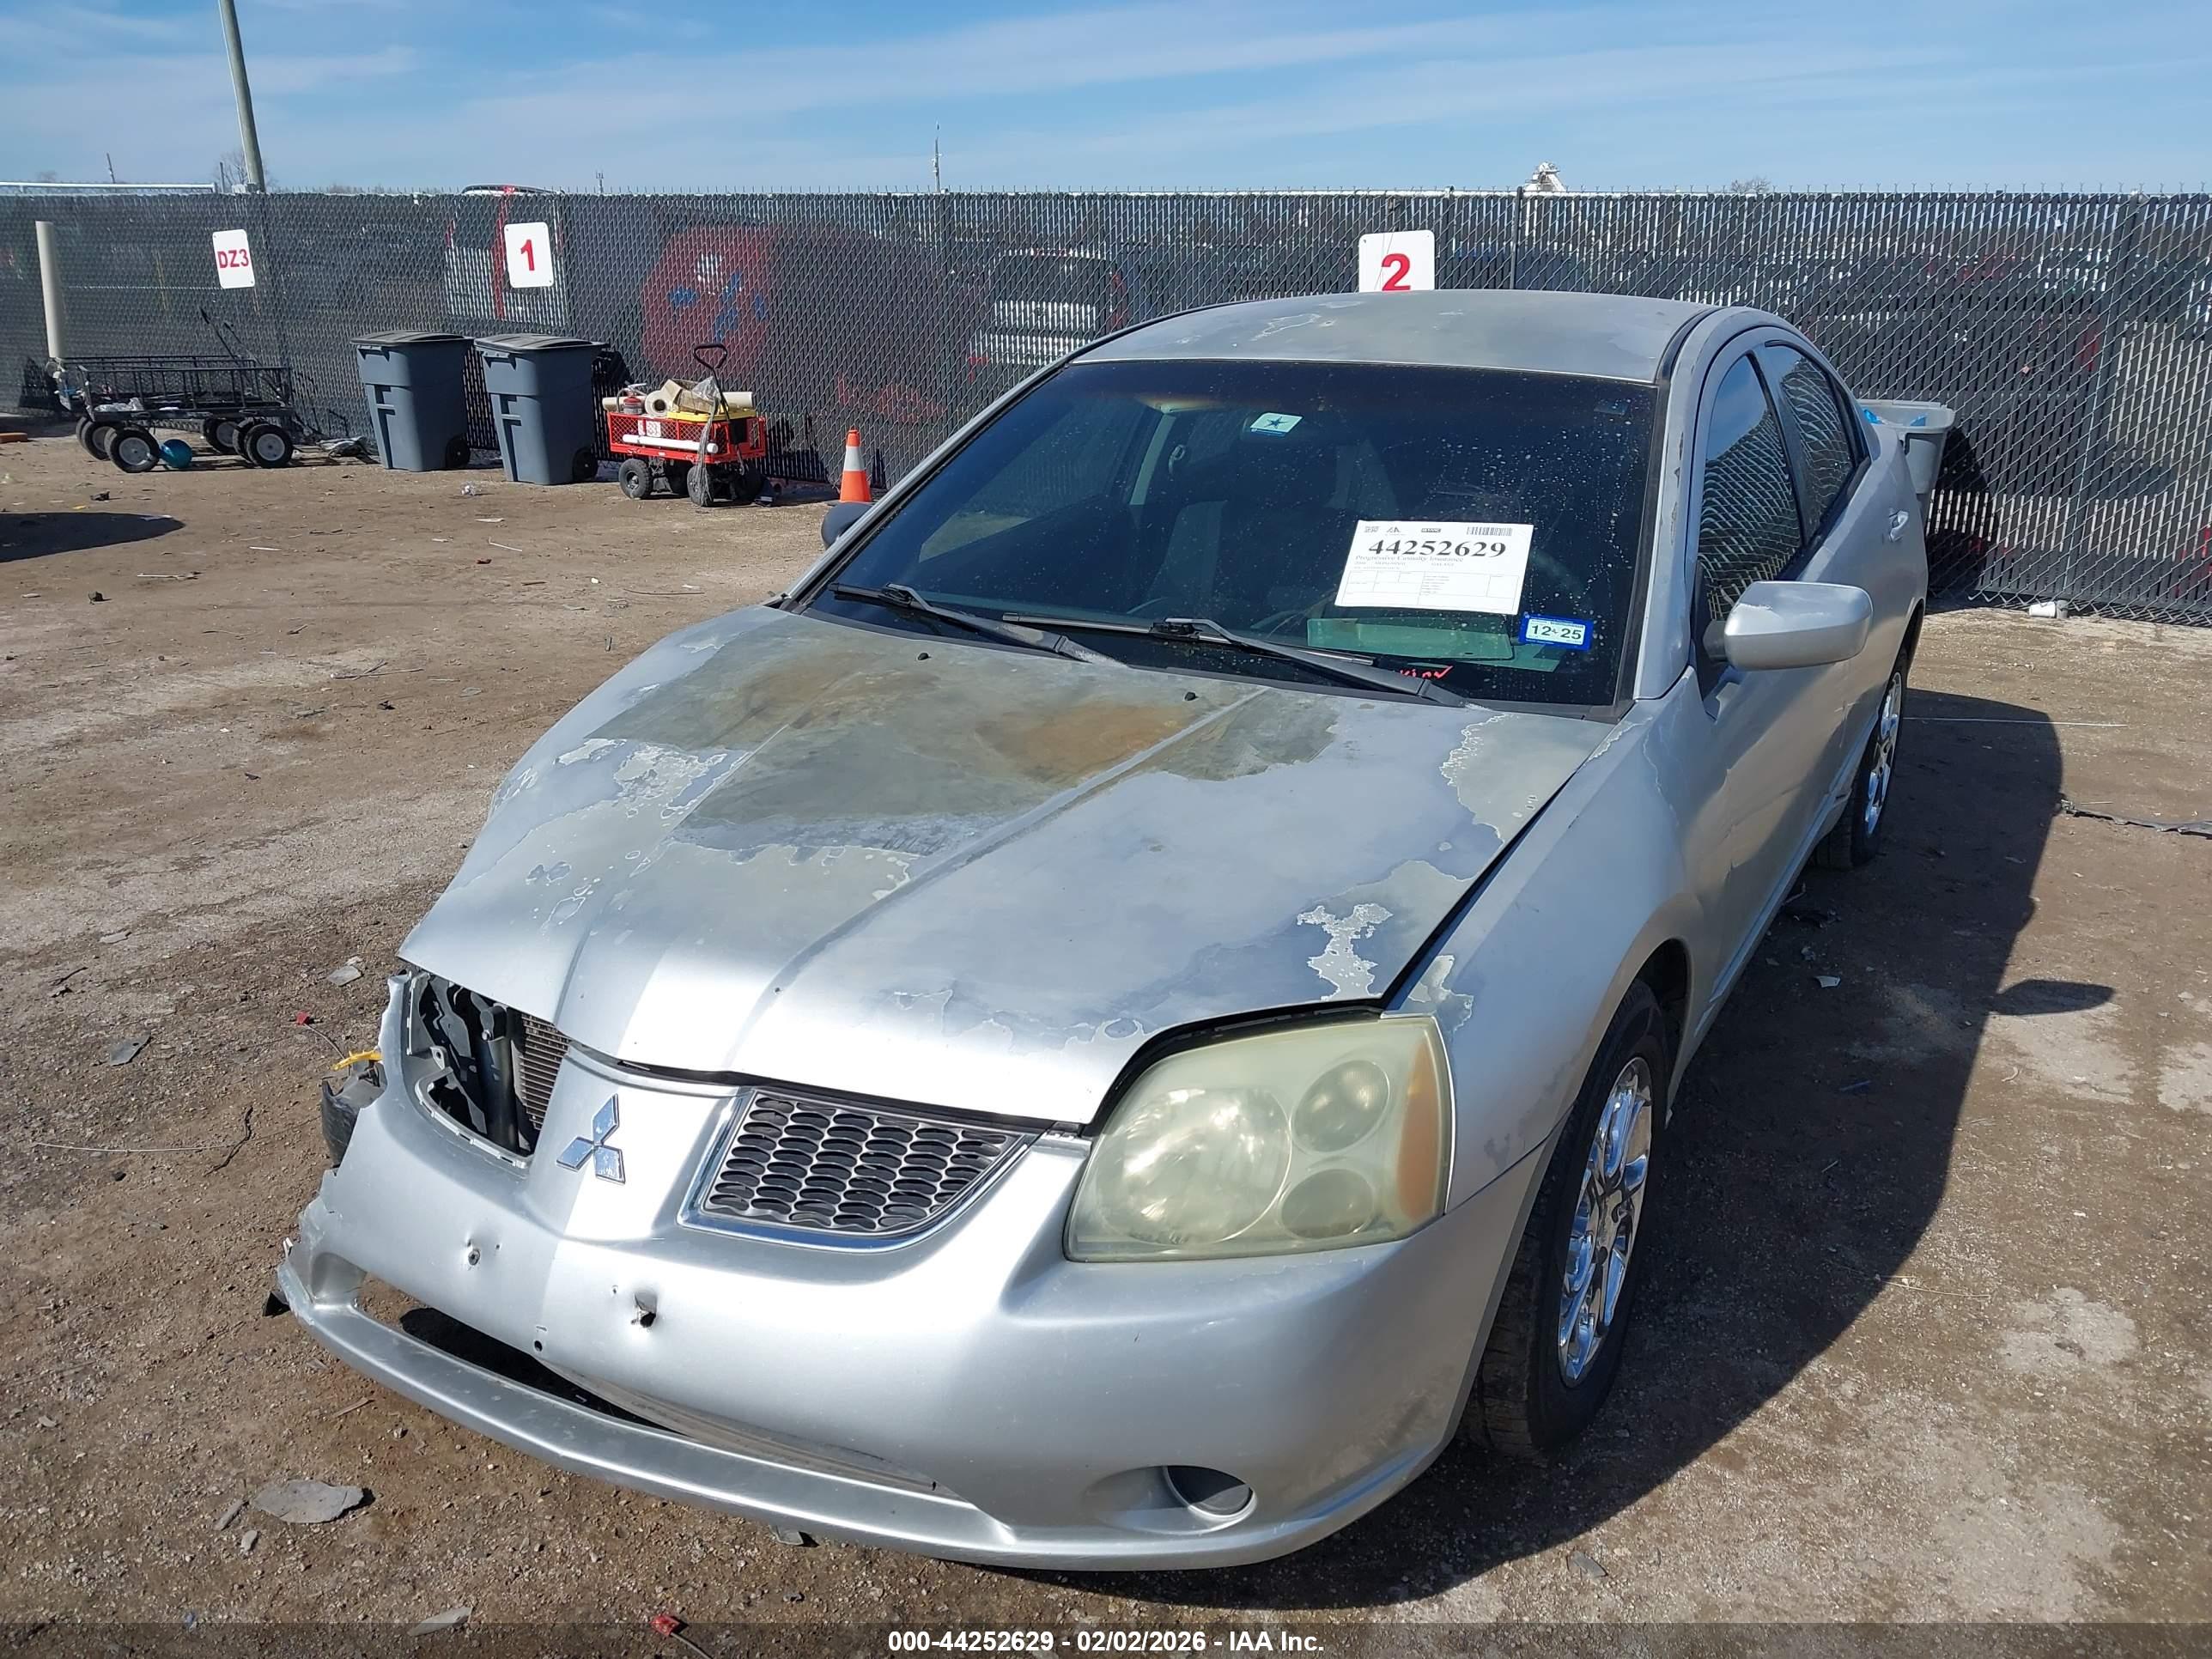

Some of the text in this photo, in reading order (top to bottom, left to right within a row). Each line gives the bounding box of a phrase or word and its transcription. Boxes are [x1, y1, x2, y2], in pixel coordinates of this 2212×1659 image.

[217, 247, 250, 269] DZ3
[520, 239, 536, 271] 1
[1381, 252, 1412, 292] 2
[1368, 539, 1506, 557] 44252629
[1532, 624, 1582, 640] 12 25
